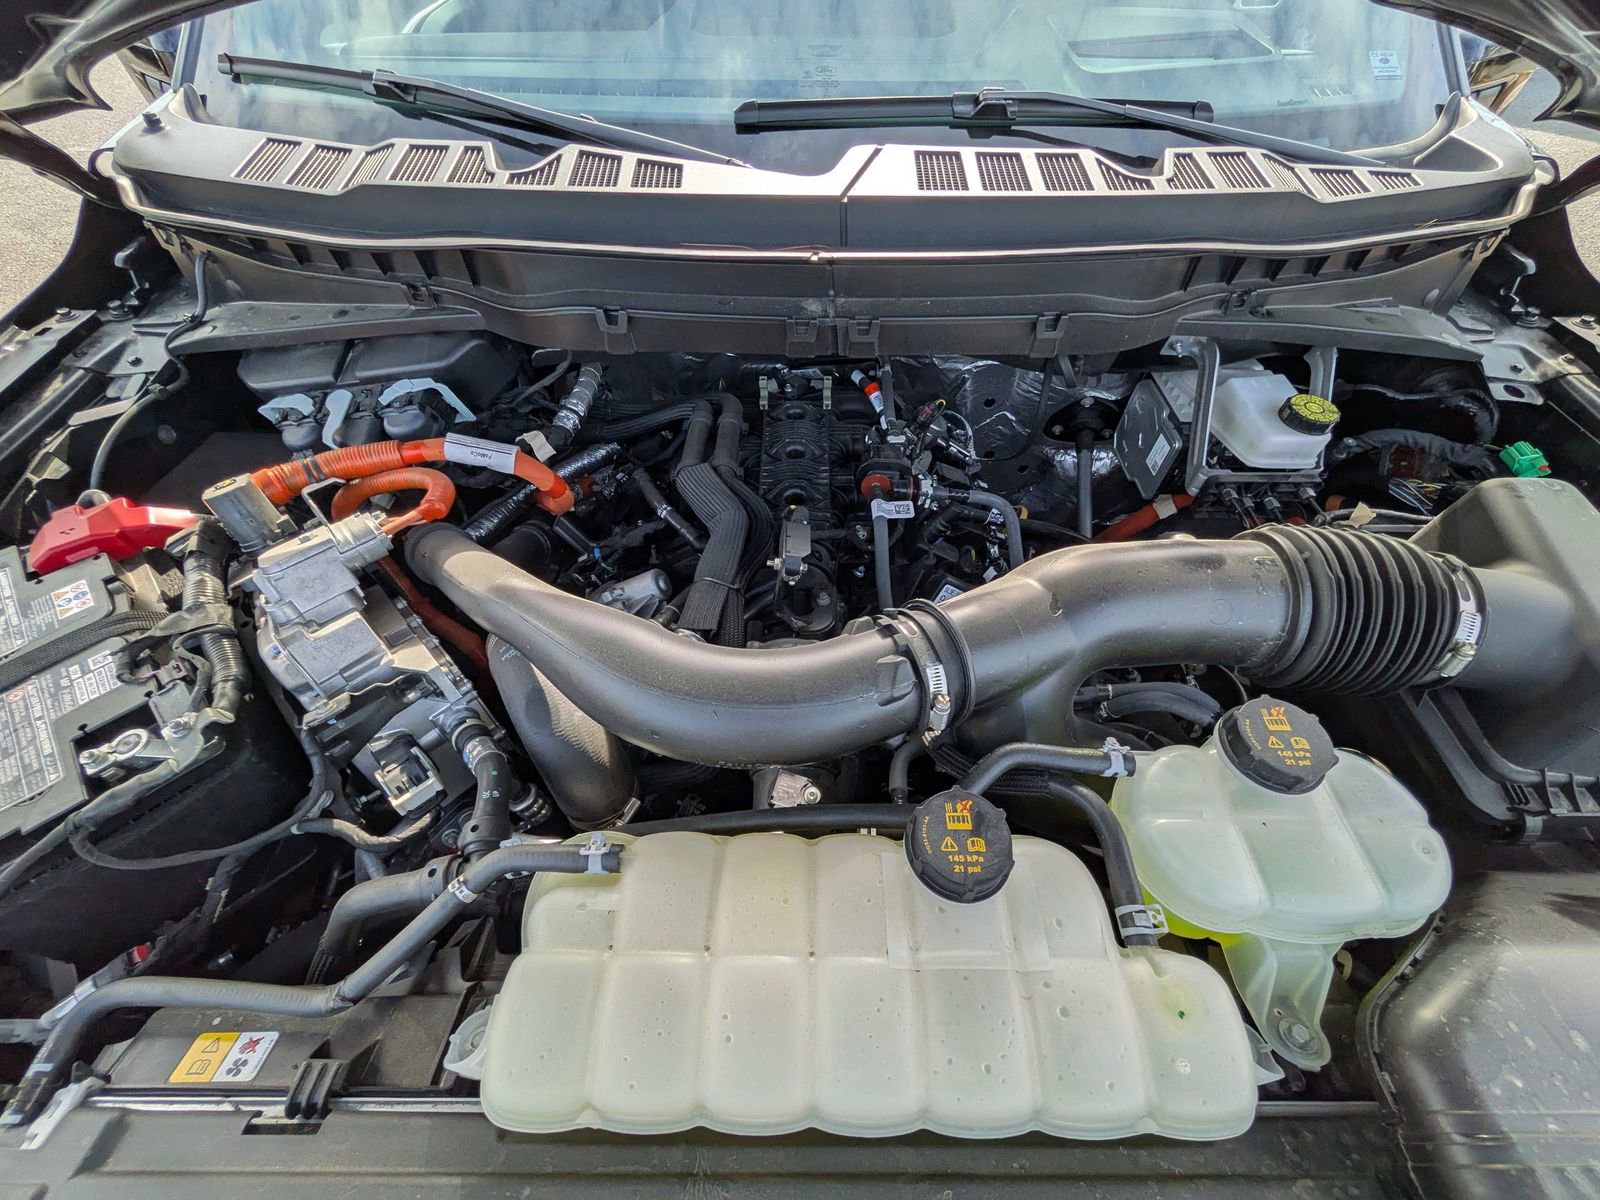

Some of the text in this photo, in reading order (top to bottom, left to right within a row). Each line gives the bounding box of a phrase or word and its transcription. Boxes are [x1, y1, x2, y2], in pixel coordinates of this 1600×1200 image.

[1277, 750, 1311, 758] 145 kPa
[1285, 758, 1311, 767] 21 psi
[948, 855, 984, 863] 145 kPa
[953, 865, 982, 874] 21 psi
